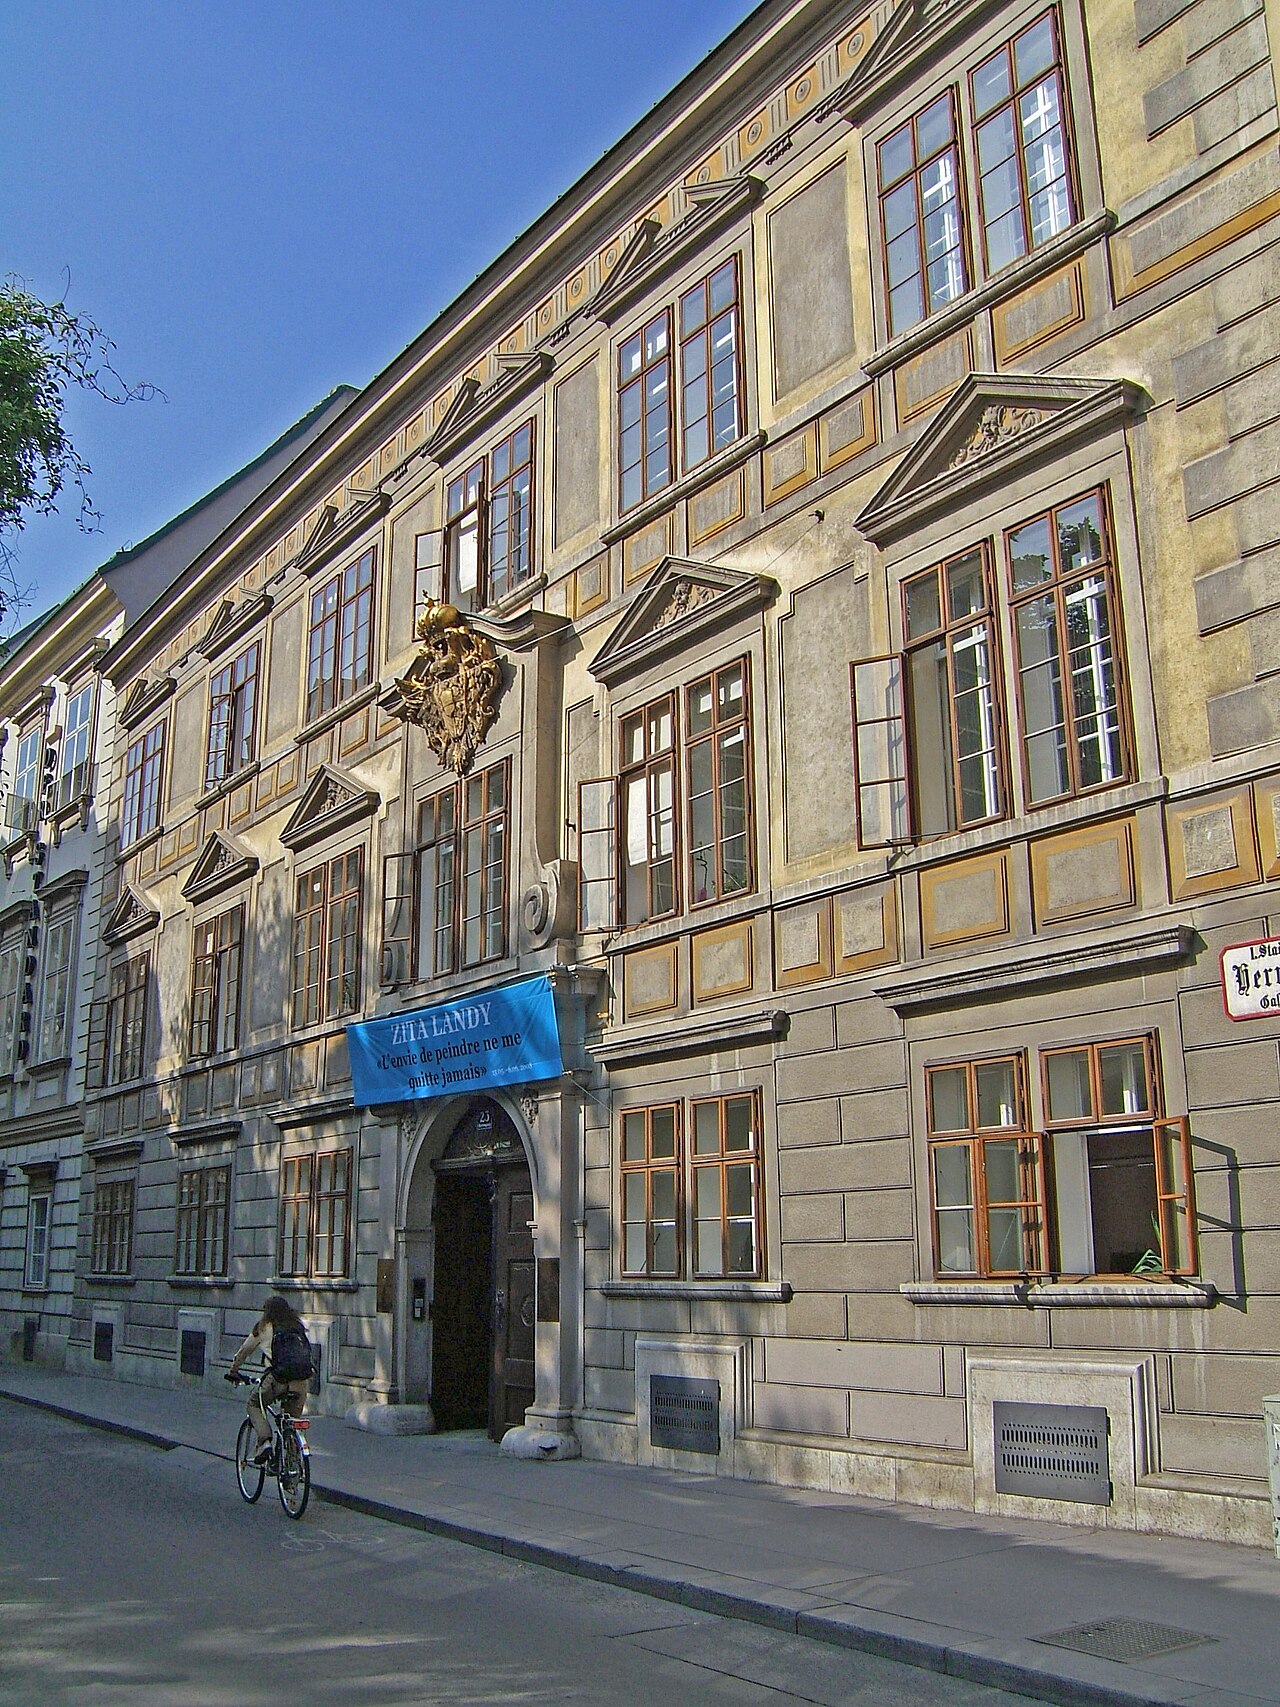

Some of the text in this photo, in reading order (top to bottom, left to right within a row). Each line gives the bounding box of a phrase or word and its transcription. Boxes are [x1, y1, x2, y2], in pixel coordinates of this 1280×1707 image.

[391, 1002, 491, 1045] ZITA LANDY
[420, 1046, 433, 1063] de
[434, 1038, 481, 1065] peindre
[483, 1036, 499, 1052] ne
[501, 1032, 522, 1048] me
[408, 1071, 440, 1092] quitte
[441, 1061, 488, 1088] jamais»
